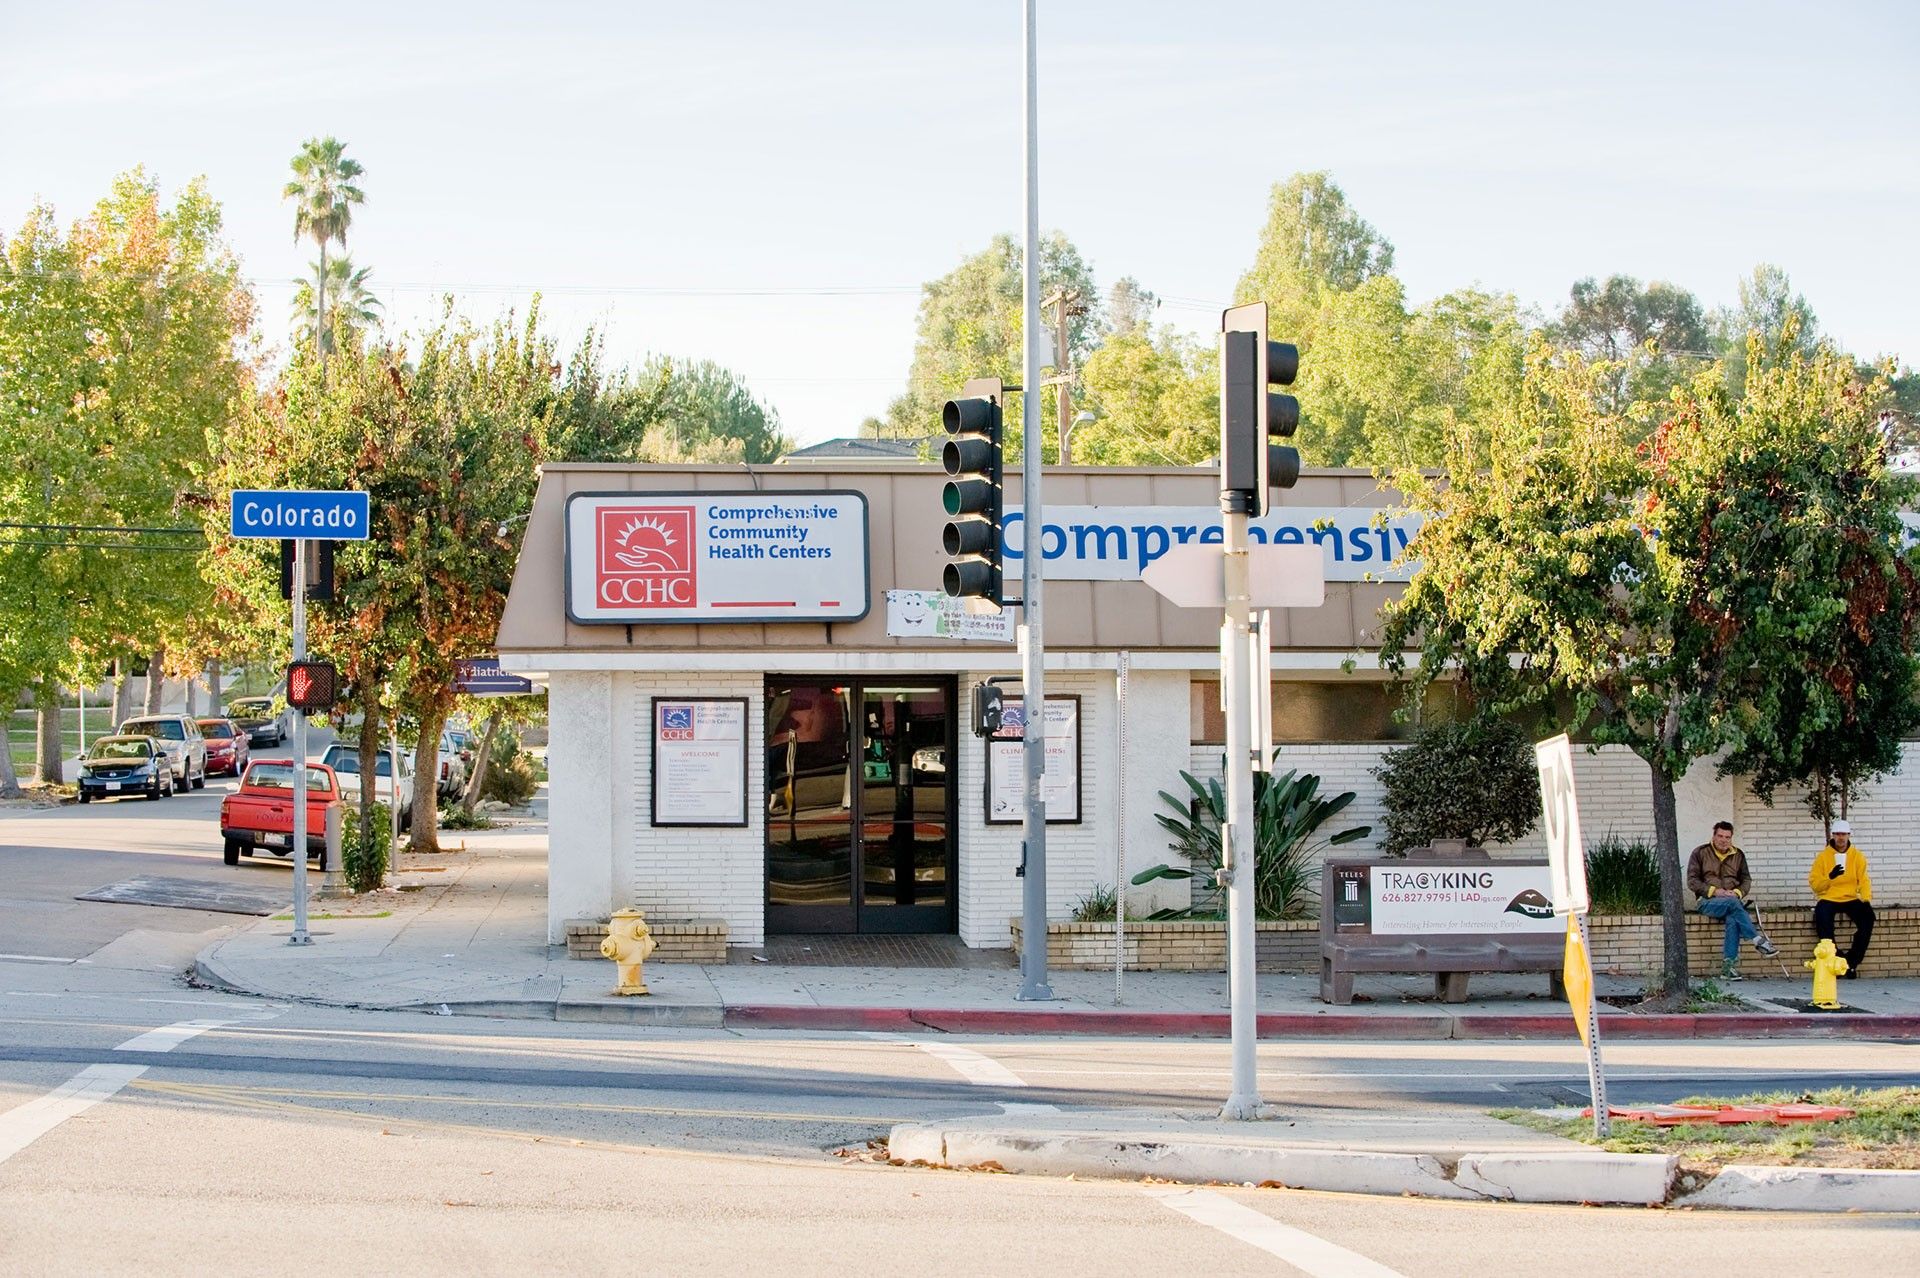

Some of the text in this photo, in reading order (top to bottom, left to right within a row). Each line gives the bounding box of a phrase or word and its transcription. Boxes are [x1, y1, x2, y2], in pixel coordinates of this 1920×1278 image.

[243, 502, 357, 527] Colorado
[708, 505, 838, 523] Comprehensive
[708, 525, 809, 542] Community
[708, 544, 832, 559] Health Centers
[601, 578, 691, 603] CCHC
[662, 730, 693, 739] CCHC
[1382, 893, 1451, 902] 626.827.9795
[1382, 920, 1523, 930] Interesting Homes for Interesting People
